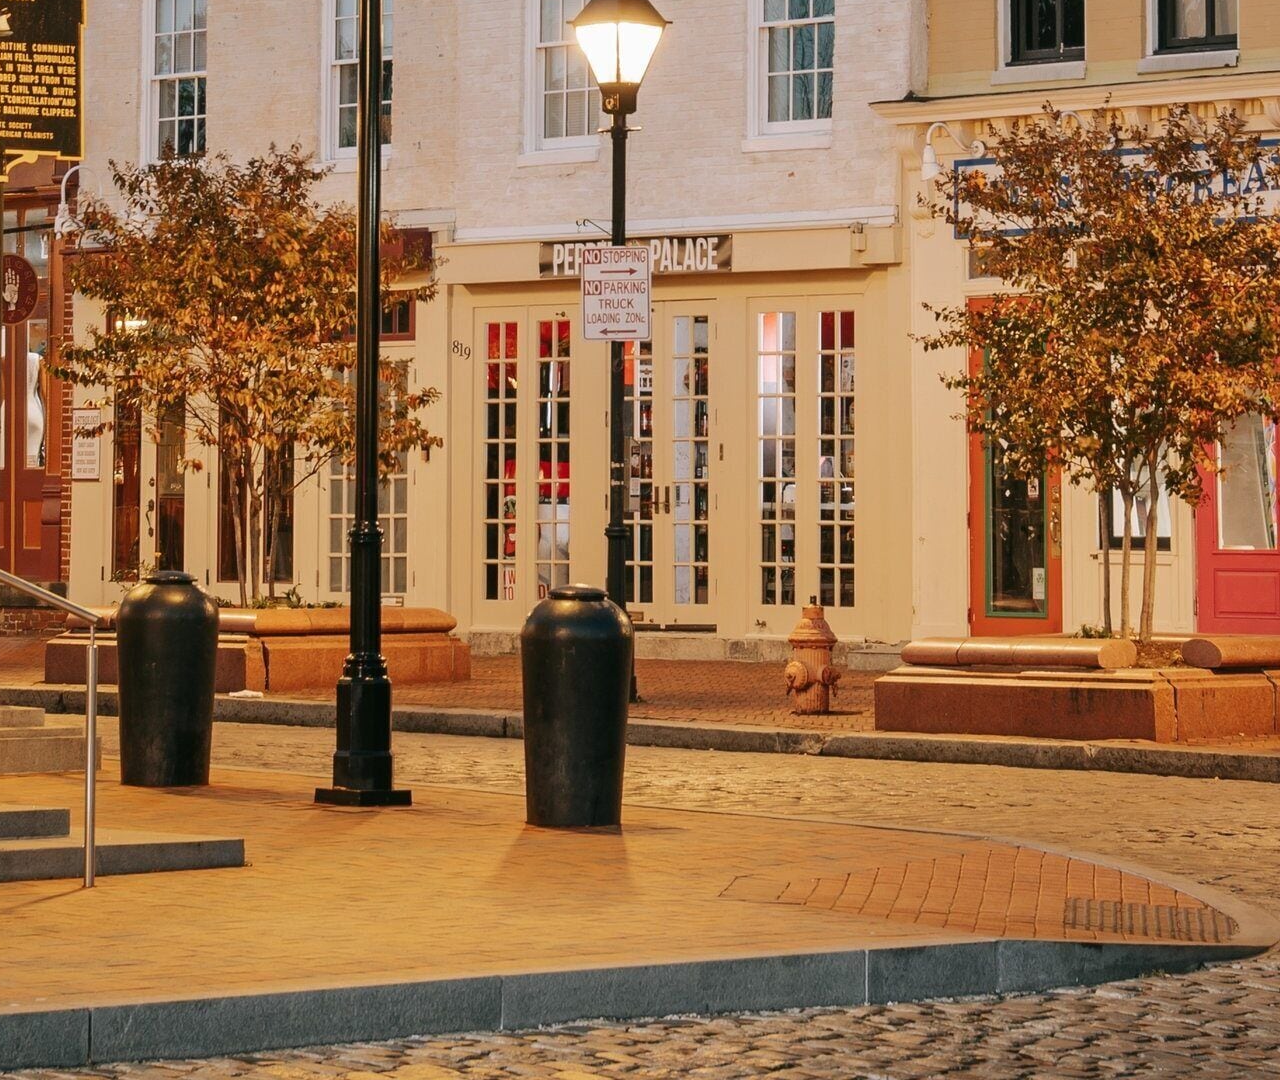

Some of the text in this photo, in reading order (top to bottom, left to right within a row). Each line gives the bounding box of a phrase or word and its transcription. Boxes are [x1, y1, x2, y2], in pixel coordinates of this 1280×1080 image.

[32, 43, 76, 54] COMMUNITY
[6, 63, 13, 72] IN
[17, 63, 33, 73] THIS
[35, 64, 54, 74] AREA
[57, 66, 76, 75] WERE
[19, 75, 39, 83] SHIPS
[41, 75, 60, 85] FROM
[63, 77, 76, 86] THE
[12, 85, 30, 94] CIVIL
[62, 98, 76, 107] AND
[3, 106, 39, 115] BALTIMORE
[8, 121, 32, 130] SOCIETY
[23, 132, 54, 140] COLONISTS
[585, 250, 646, 264] NO STOPPING
[650, 237, 718, 272] PALACE
[585, 281, 646, 295] NO PARKING
[598, 298, 634, 309] TRUCK
[587, 313, 620, 324] LOADING
[452, 340, 471, 360] 819
